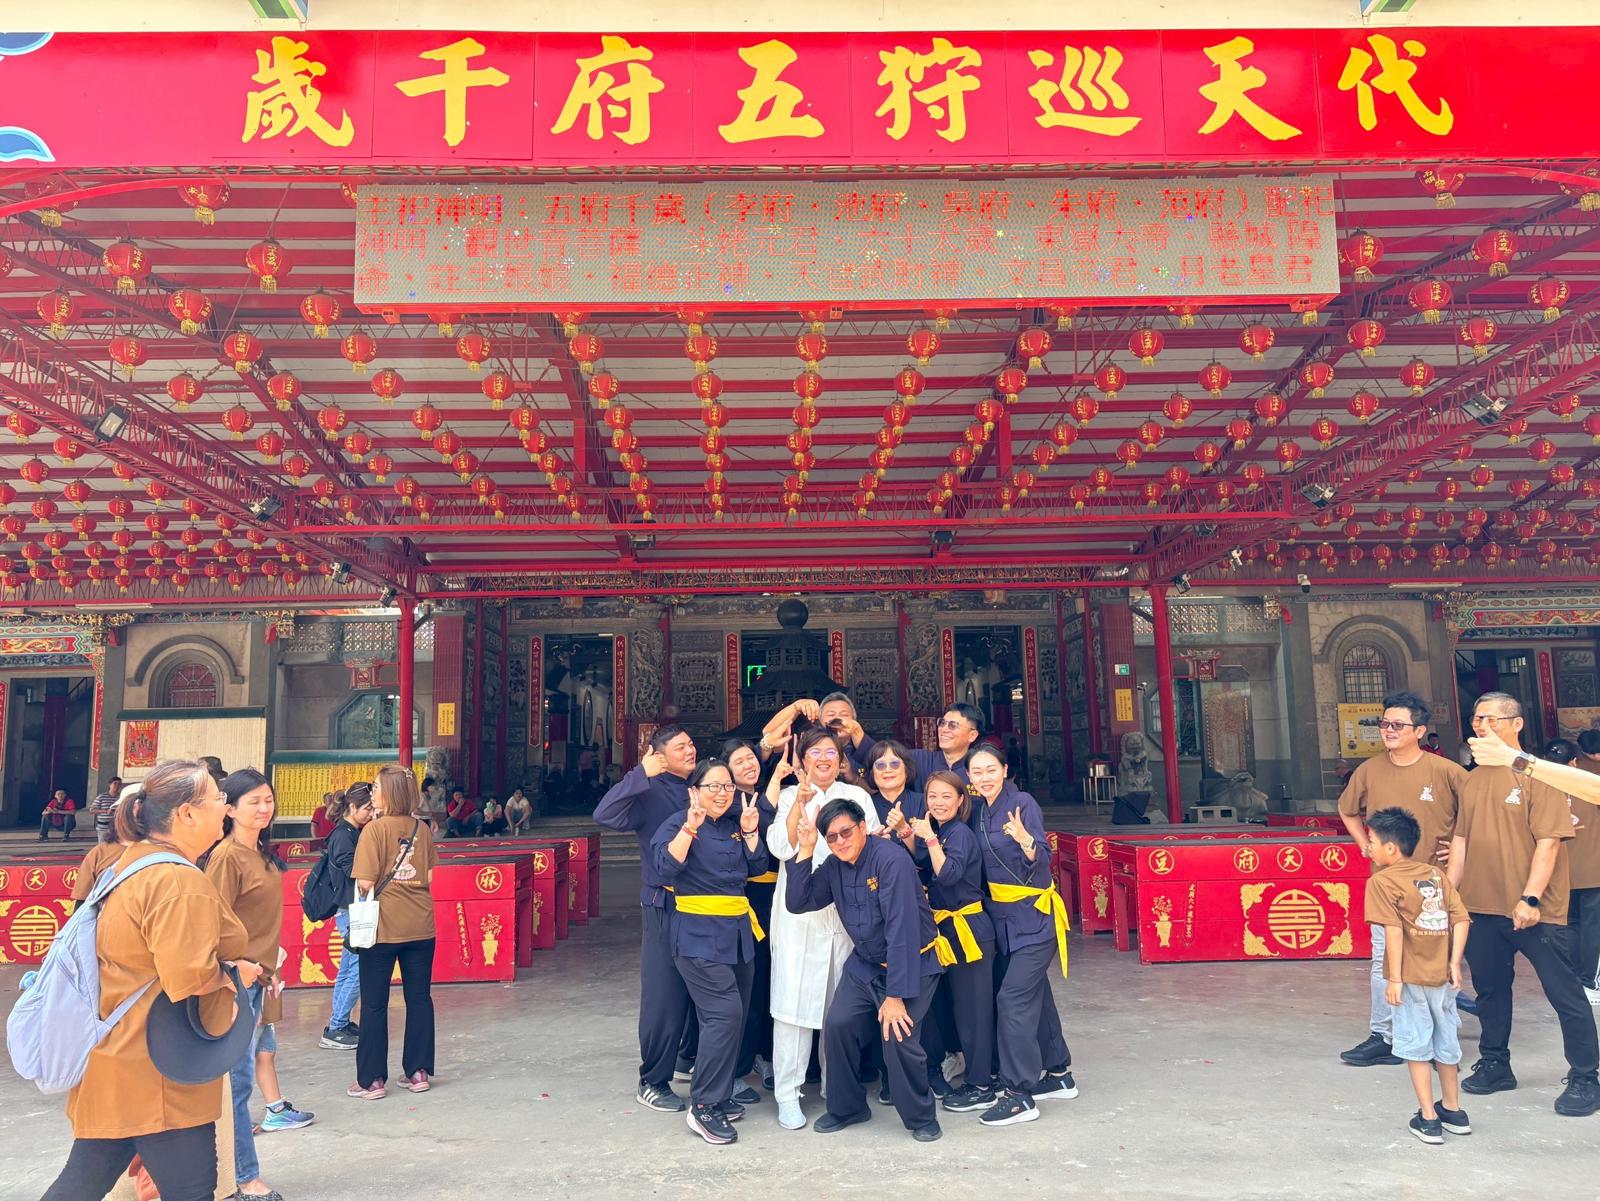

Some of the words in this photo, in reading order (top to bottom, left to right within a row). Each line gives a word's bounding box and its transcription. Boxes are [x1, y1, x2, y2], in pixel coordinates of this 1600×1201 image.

[245, 36, 1453, 146] 代天巡狩五府千歲
[1153, 850, 1171, 873] 豆
[479, 868, 500, 890] 麻
